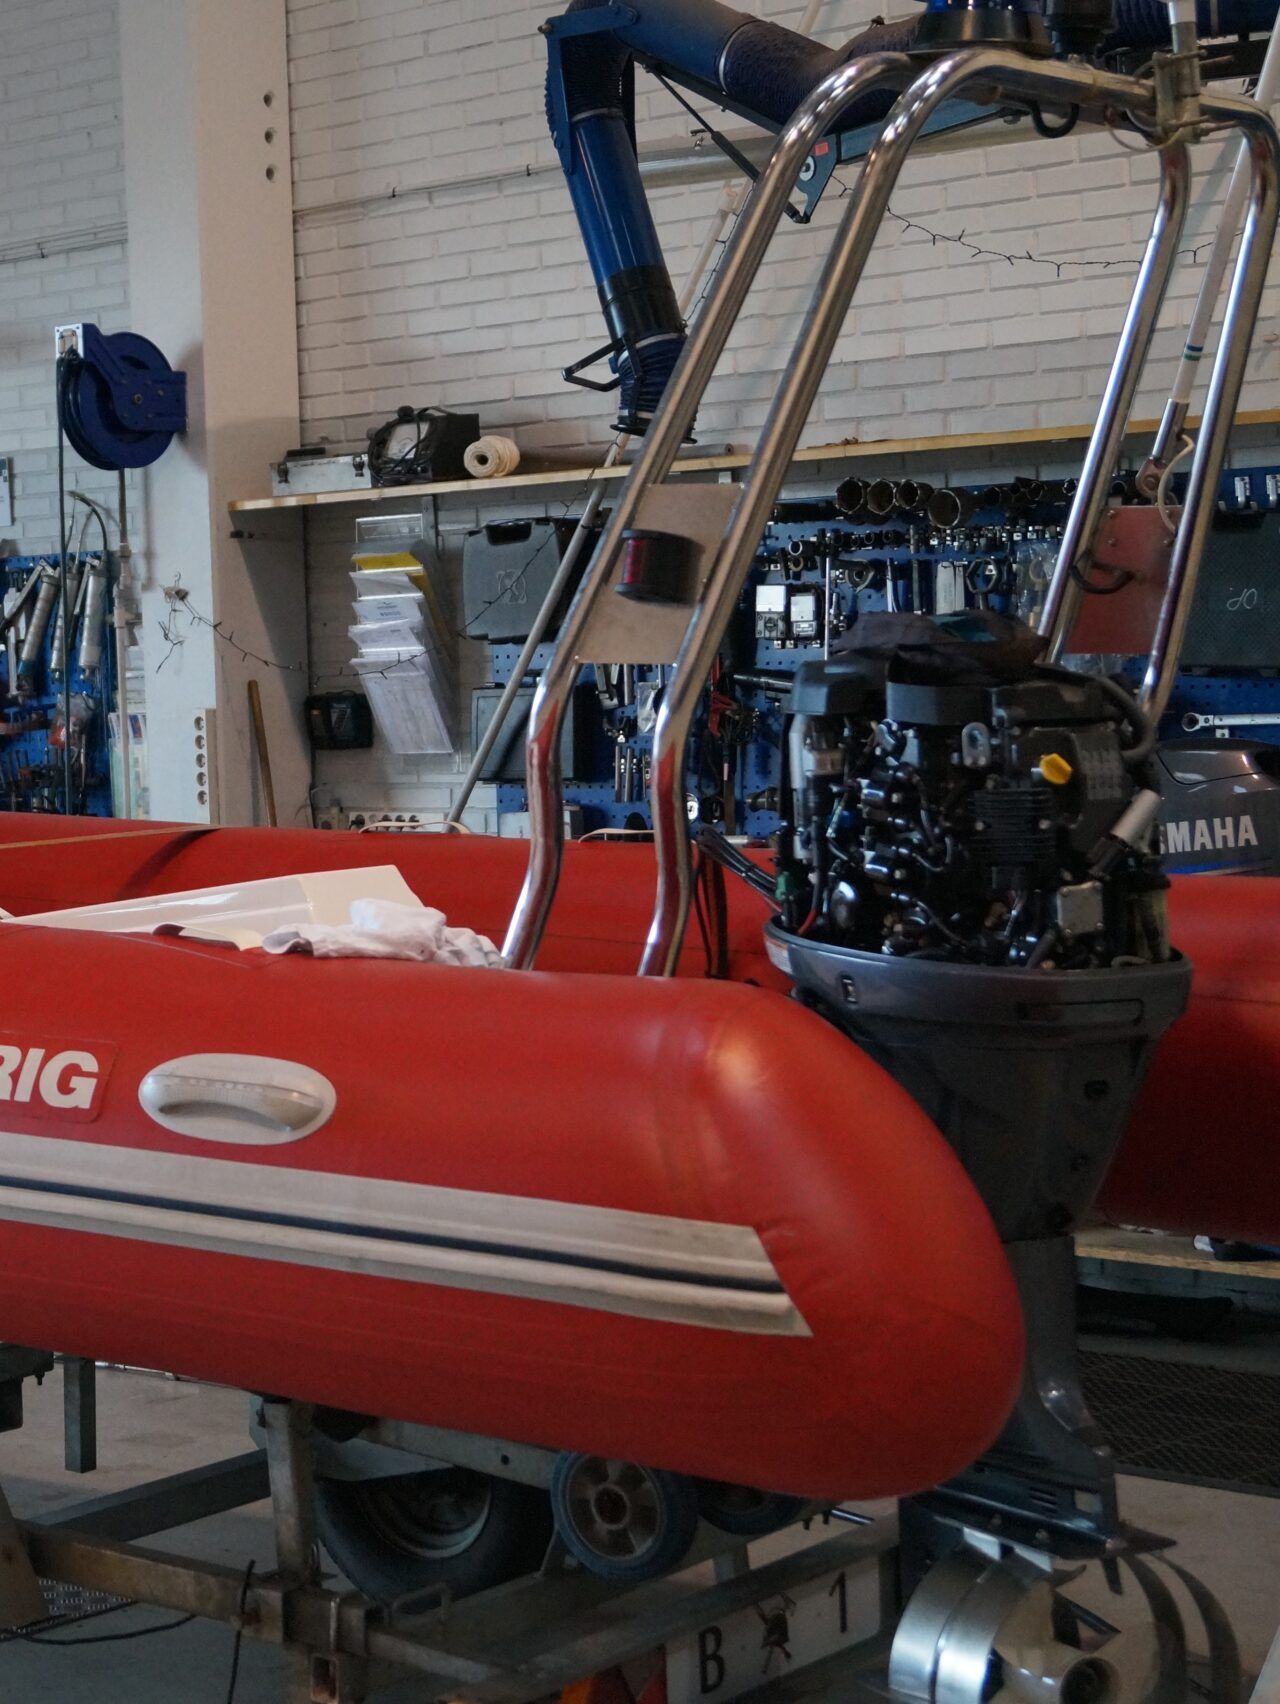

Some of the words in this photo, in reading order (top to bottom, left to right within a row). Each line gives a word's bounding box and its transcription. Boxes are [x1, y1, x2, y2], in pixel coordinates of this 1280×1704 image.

[1160, 814, 1259, 854] MAHA
[698, 1625, 726, 1695] B
[829, 1570, 849, 1634] 1
